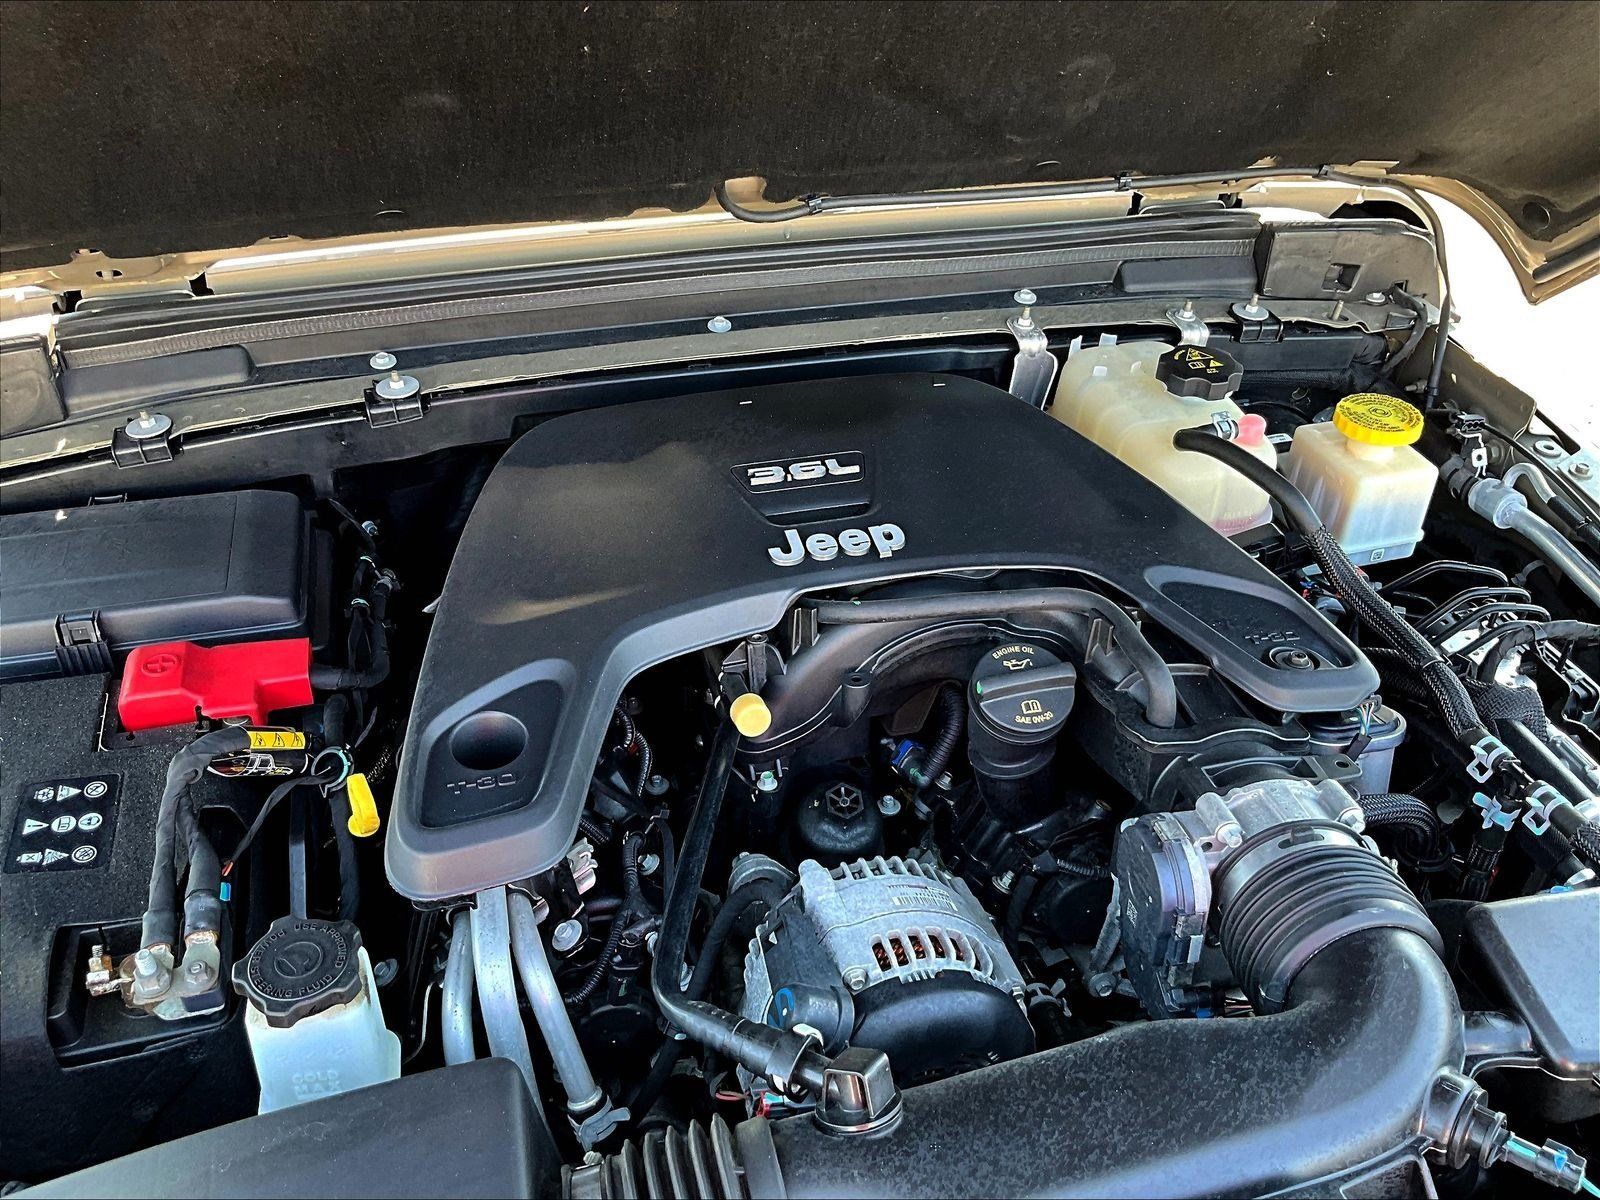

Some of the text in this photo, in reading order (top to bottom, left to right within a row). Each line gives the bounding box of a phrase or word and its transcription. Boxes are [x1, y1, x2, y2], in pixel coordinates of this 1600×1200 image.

[747, 458, 860, 486] 3.6L
[767, 523, 906, 567] Jeep
[992, 645, 1035, 660] ENGINE OIL
[1015, 715, 1032, 724] SAE
[446, 773, 517, 795] T-30
[294, 922, 348, 969] USE APPROVED
[250, 928, 334, 999] POWER STEERING FLUID
